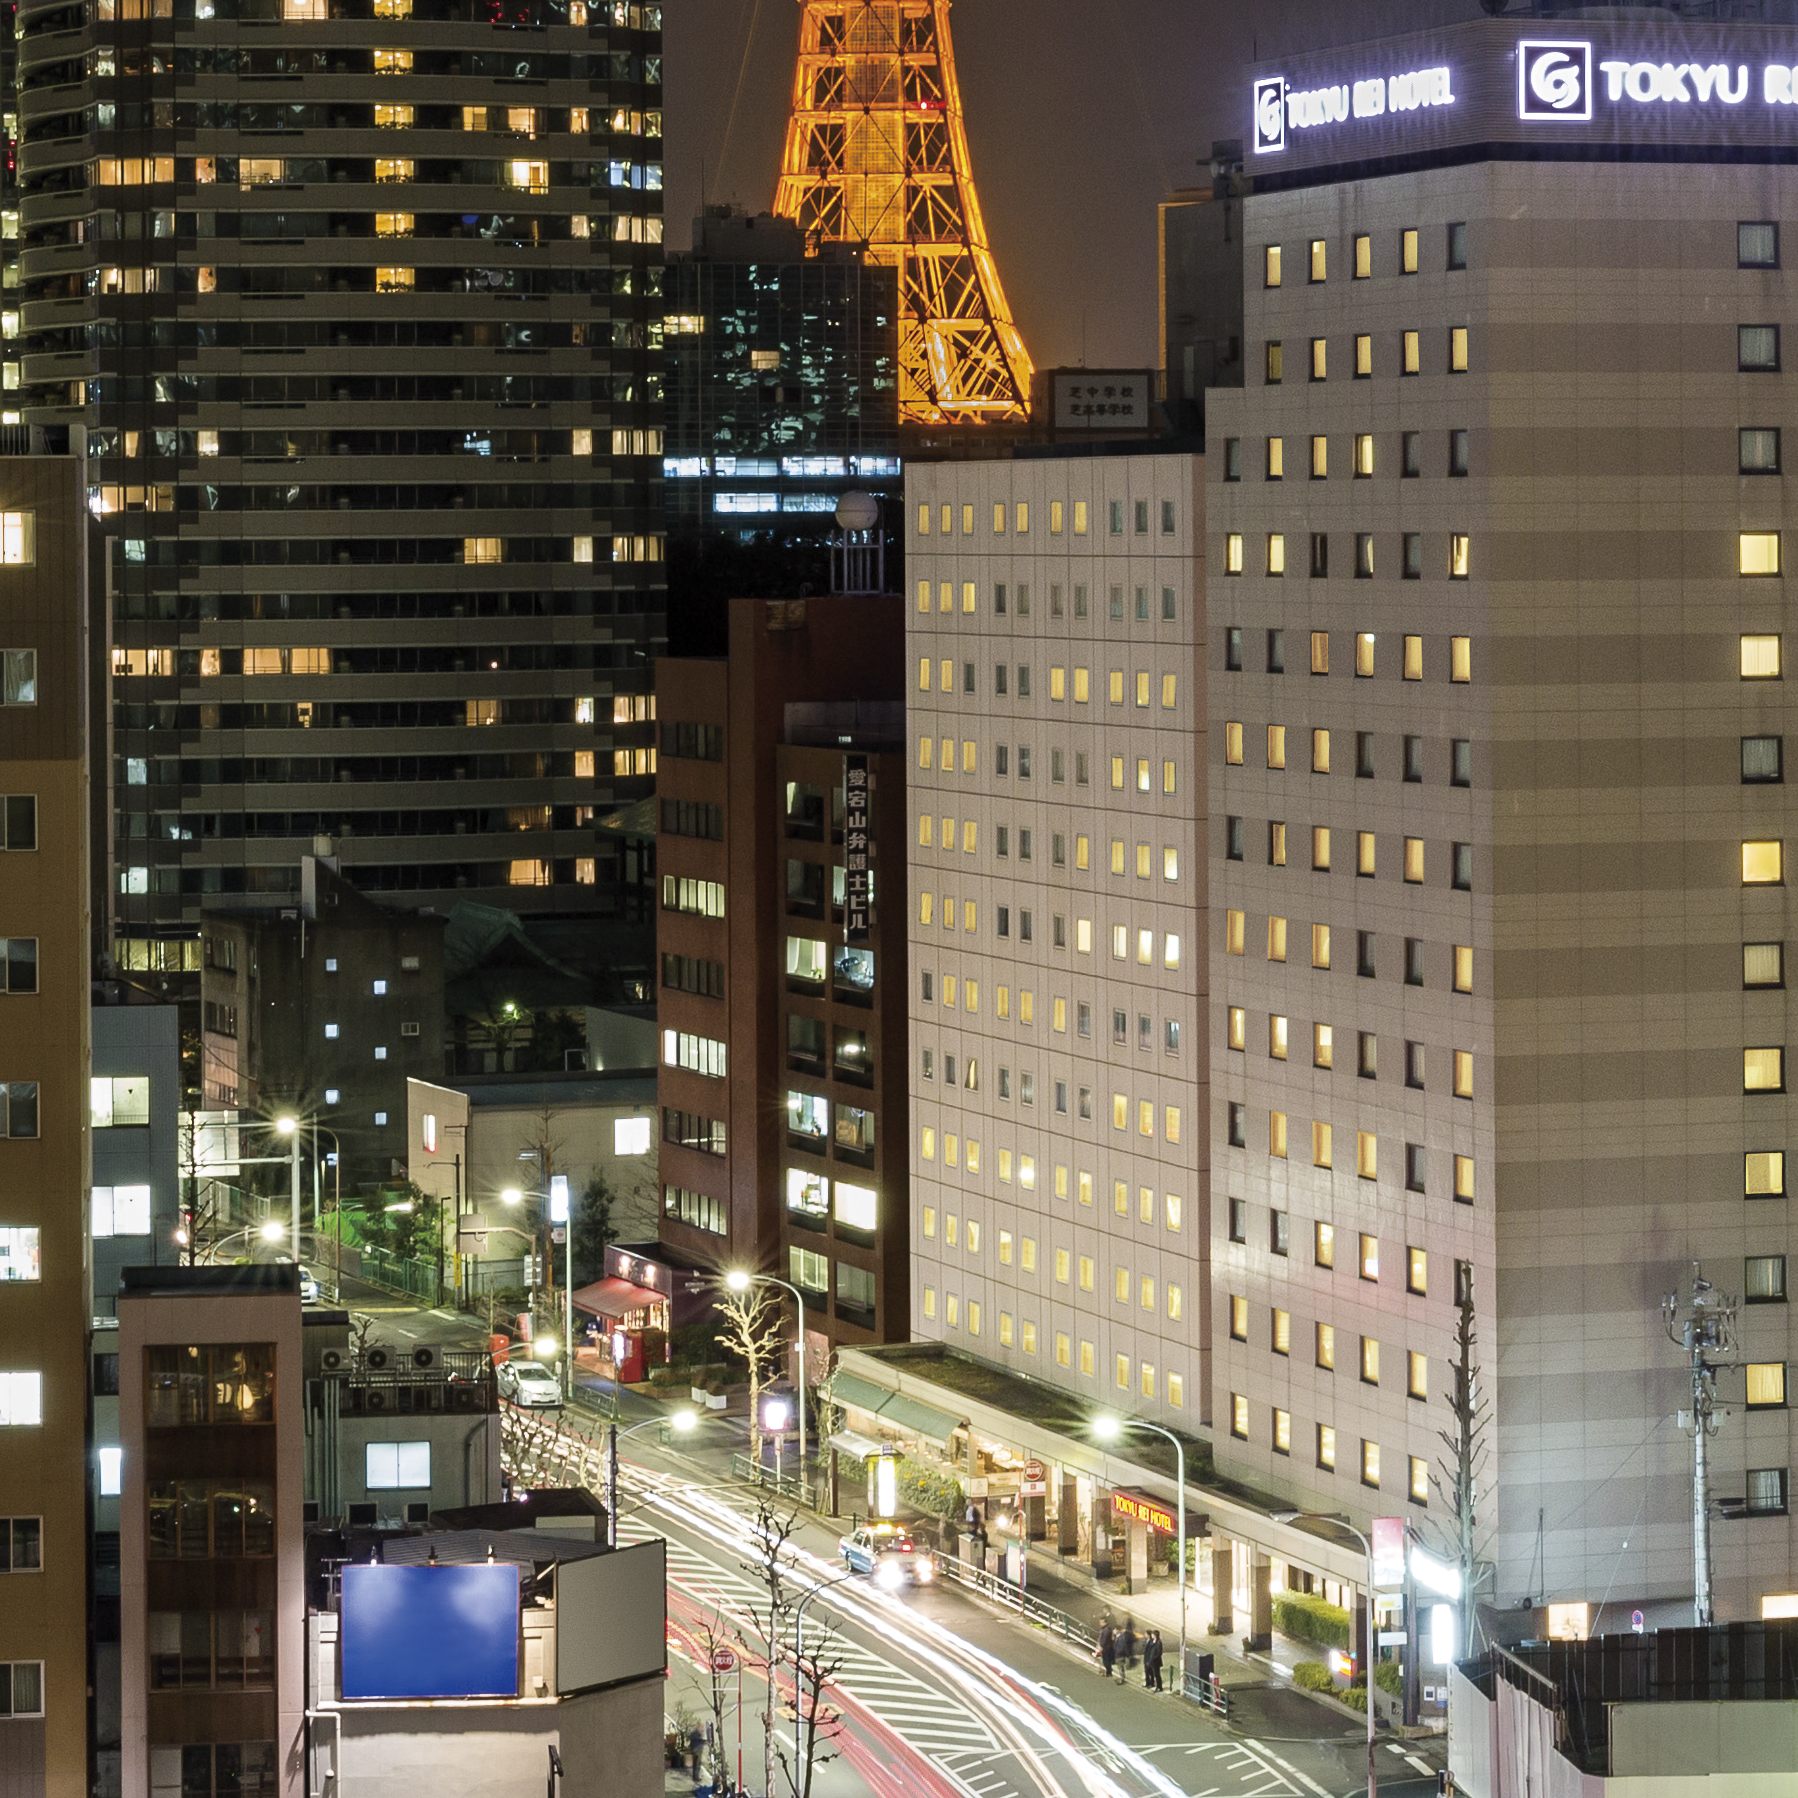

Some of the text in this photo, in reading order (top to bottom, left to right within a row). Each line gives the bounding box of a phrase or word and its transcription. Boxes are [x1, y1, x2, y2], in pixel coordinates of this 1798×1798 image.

[1388, 66, 1456, 113] HOTEL
[1599, 61, 1748, 104] TOKYU
[848, 769, 867, 930] 愛宕山弁護士ビル
[1114, 1493, 1138, 1517] TOKYU
[1150, 1509, 1175, 1533] HOTEL
